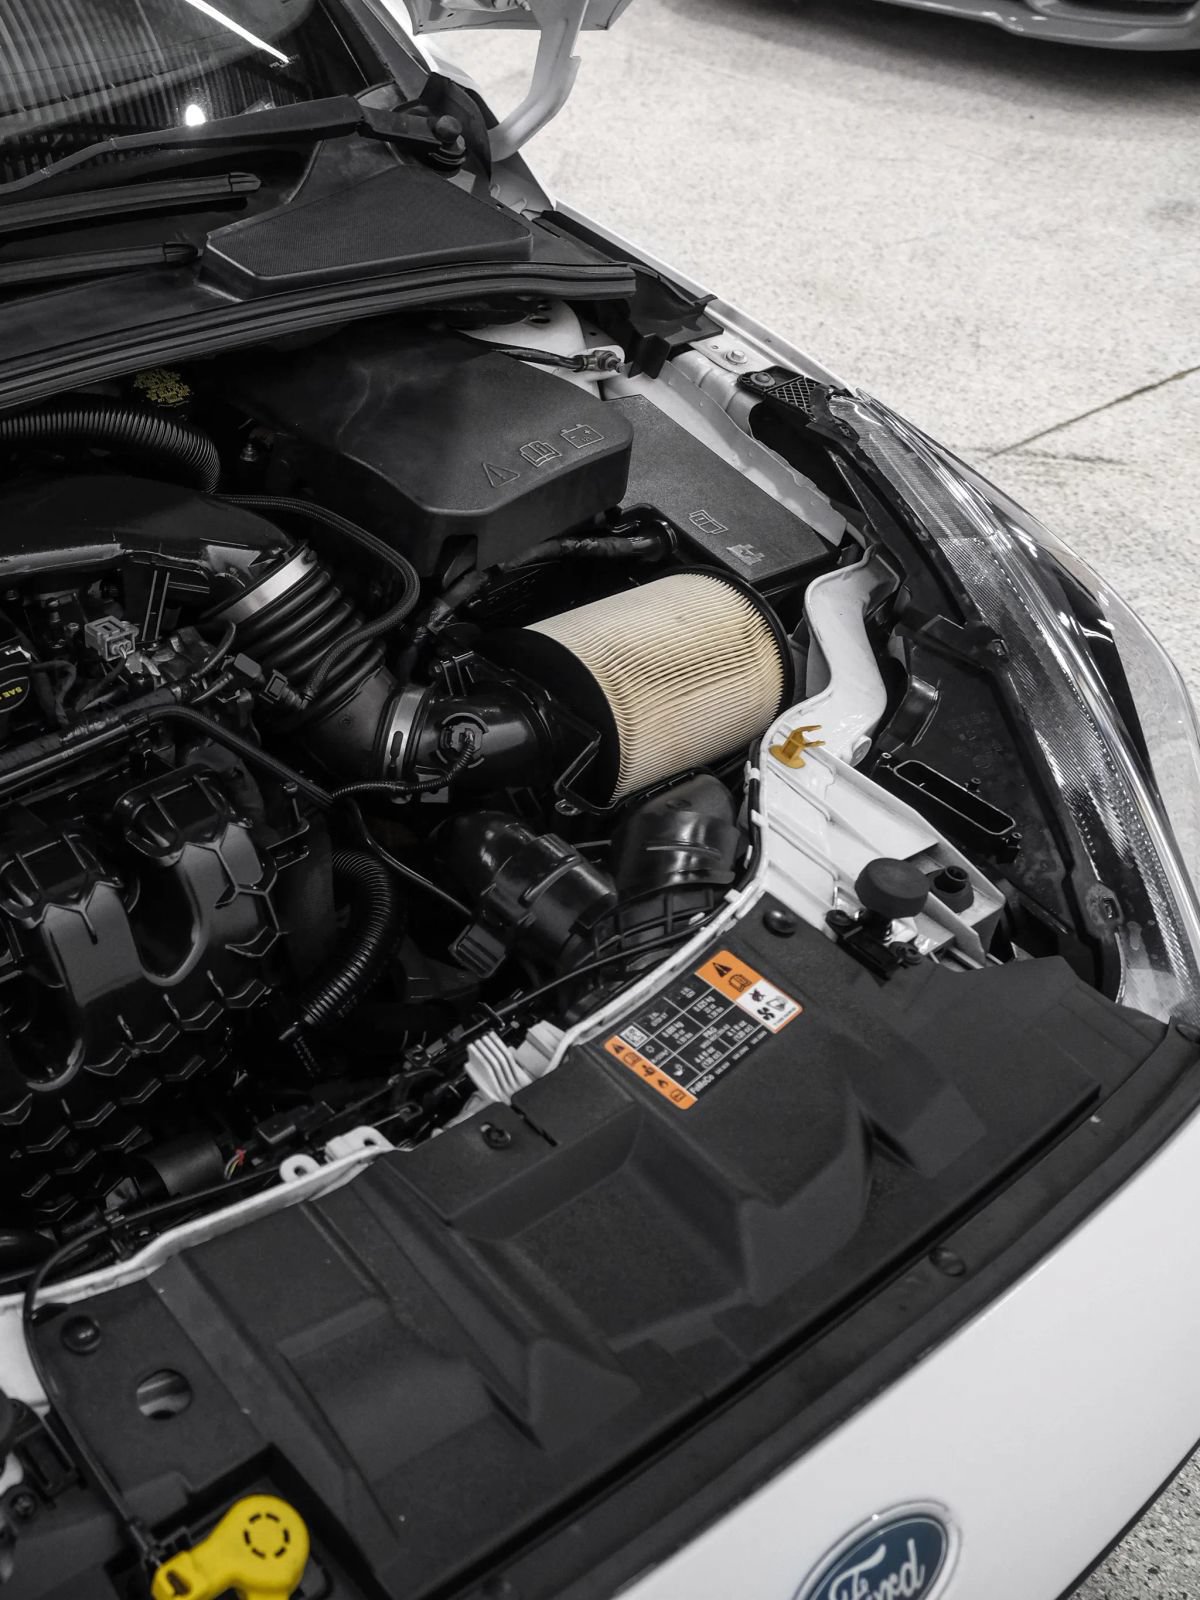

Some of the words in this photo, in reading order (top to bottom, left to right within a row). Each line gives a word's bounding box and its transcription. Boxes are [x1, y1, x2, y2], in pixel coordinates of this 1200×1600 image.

[2, 686, 23, 698] SAE
[702, 1026, 718, 1039] PAG
[828, 1538, 924, 1600] Ford
